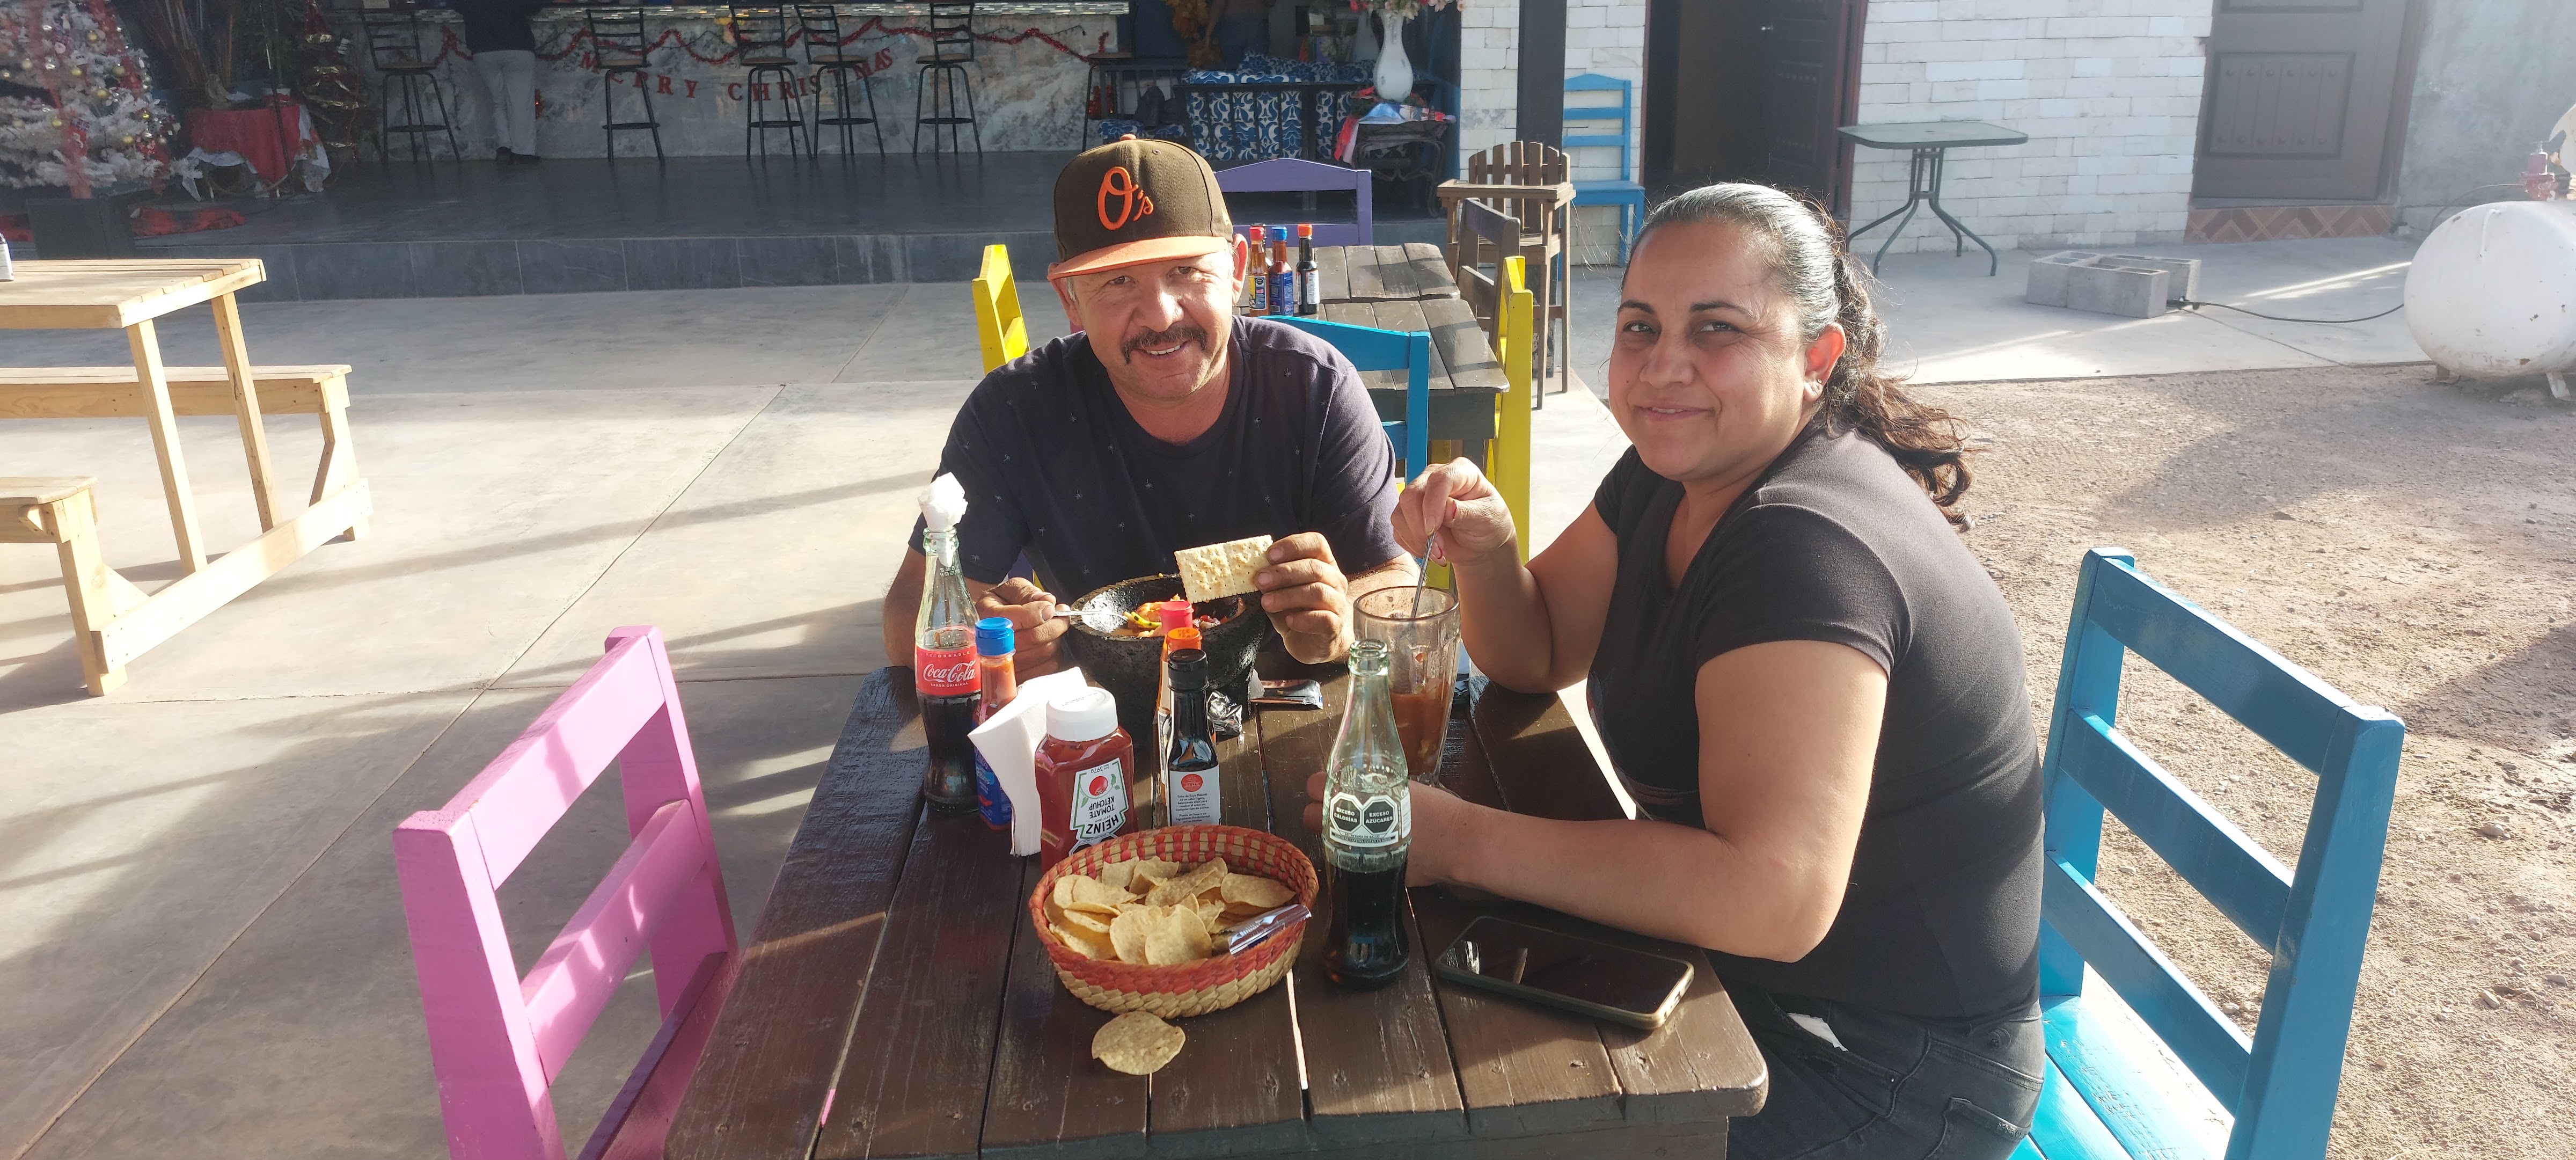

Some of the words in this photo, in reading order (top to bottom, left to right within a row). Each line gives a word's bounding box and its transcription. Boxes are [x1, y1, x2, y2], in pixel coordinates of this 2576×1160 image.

[1097, 166, 1154, 230] O's
[1089, 796, 1114, 811] KETCHUP
[1089, 804, 1115, 819] TOMATE
[1334, 813, 1358, 823] CALORÍAS
[1336, 807, 1355, 816] EXCESO
[1086, 814, 1119, 834] HEINZ
[1366, 816, 1393, 824] AZÚCARES
